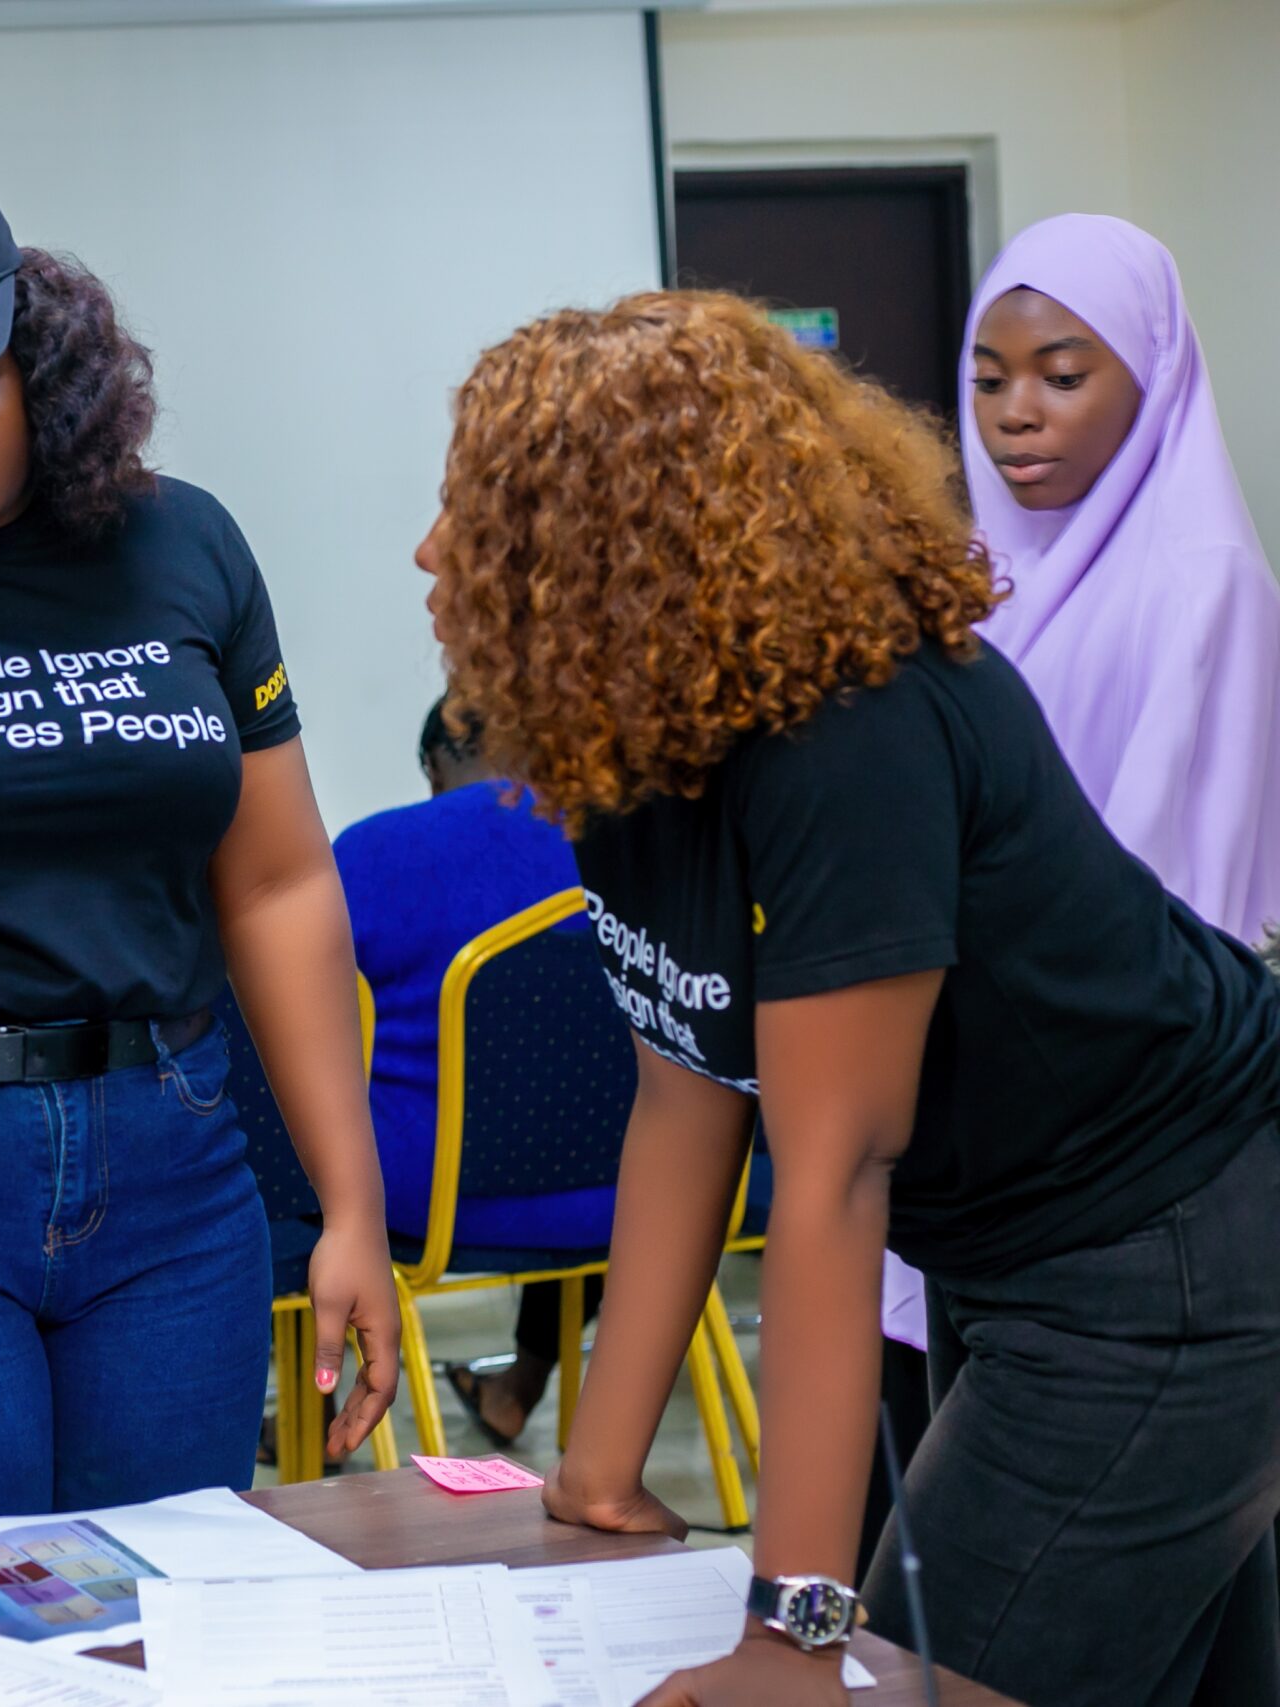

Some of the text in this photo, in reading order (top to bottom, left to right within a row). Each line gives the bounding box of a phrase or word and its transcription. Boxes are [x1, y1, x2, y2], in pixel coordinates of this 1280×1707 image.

[39, 640, 171, 679] Ignore
[53, 671, 147, 706] that
[80, 706, 226, 749] People
